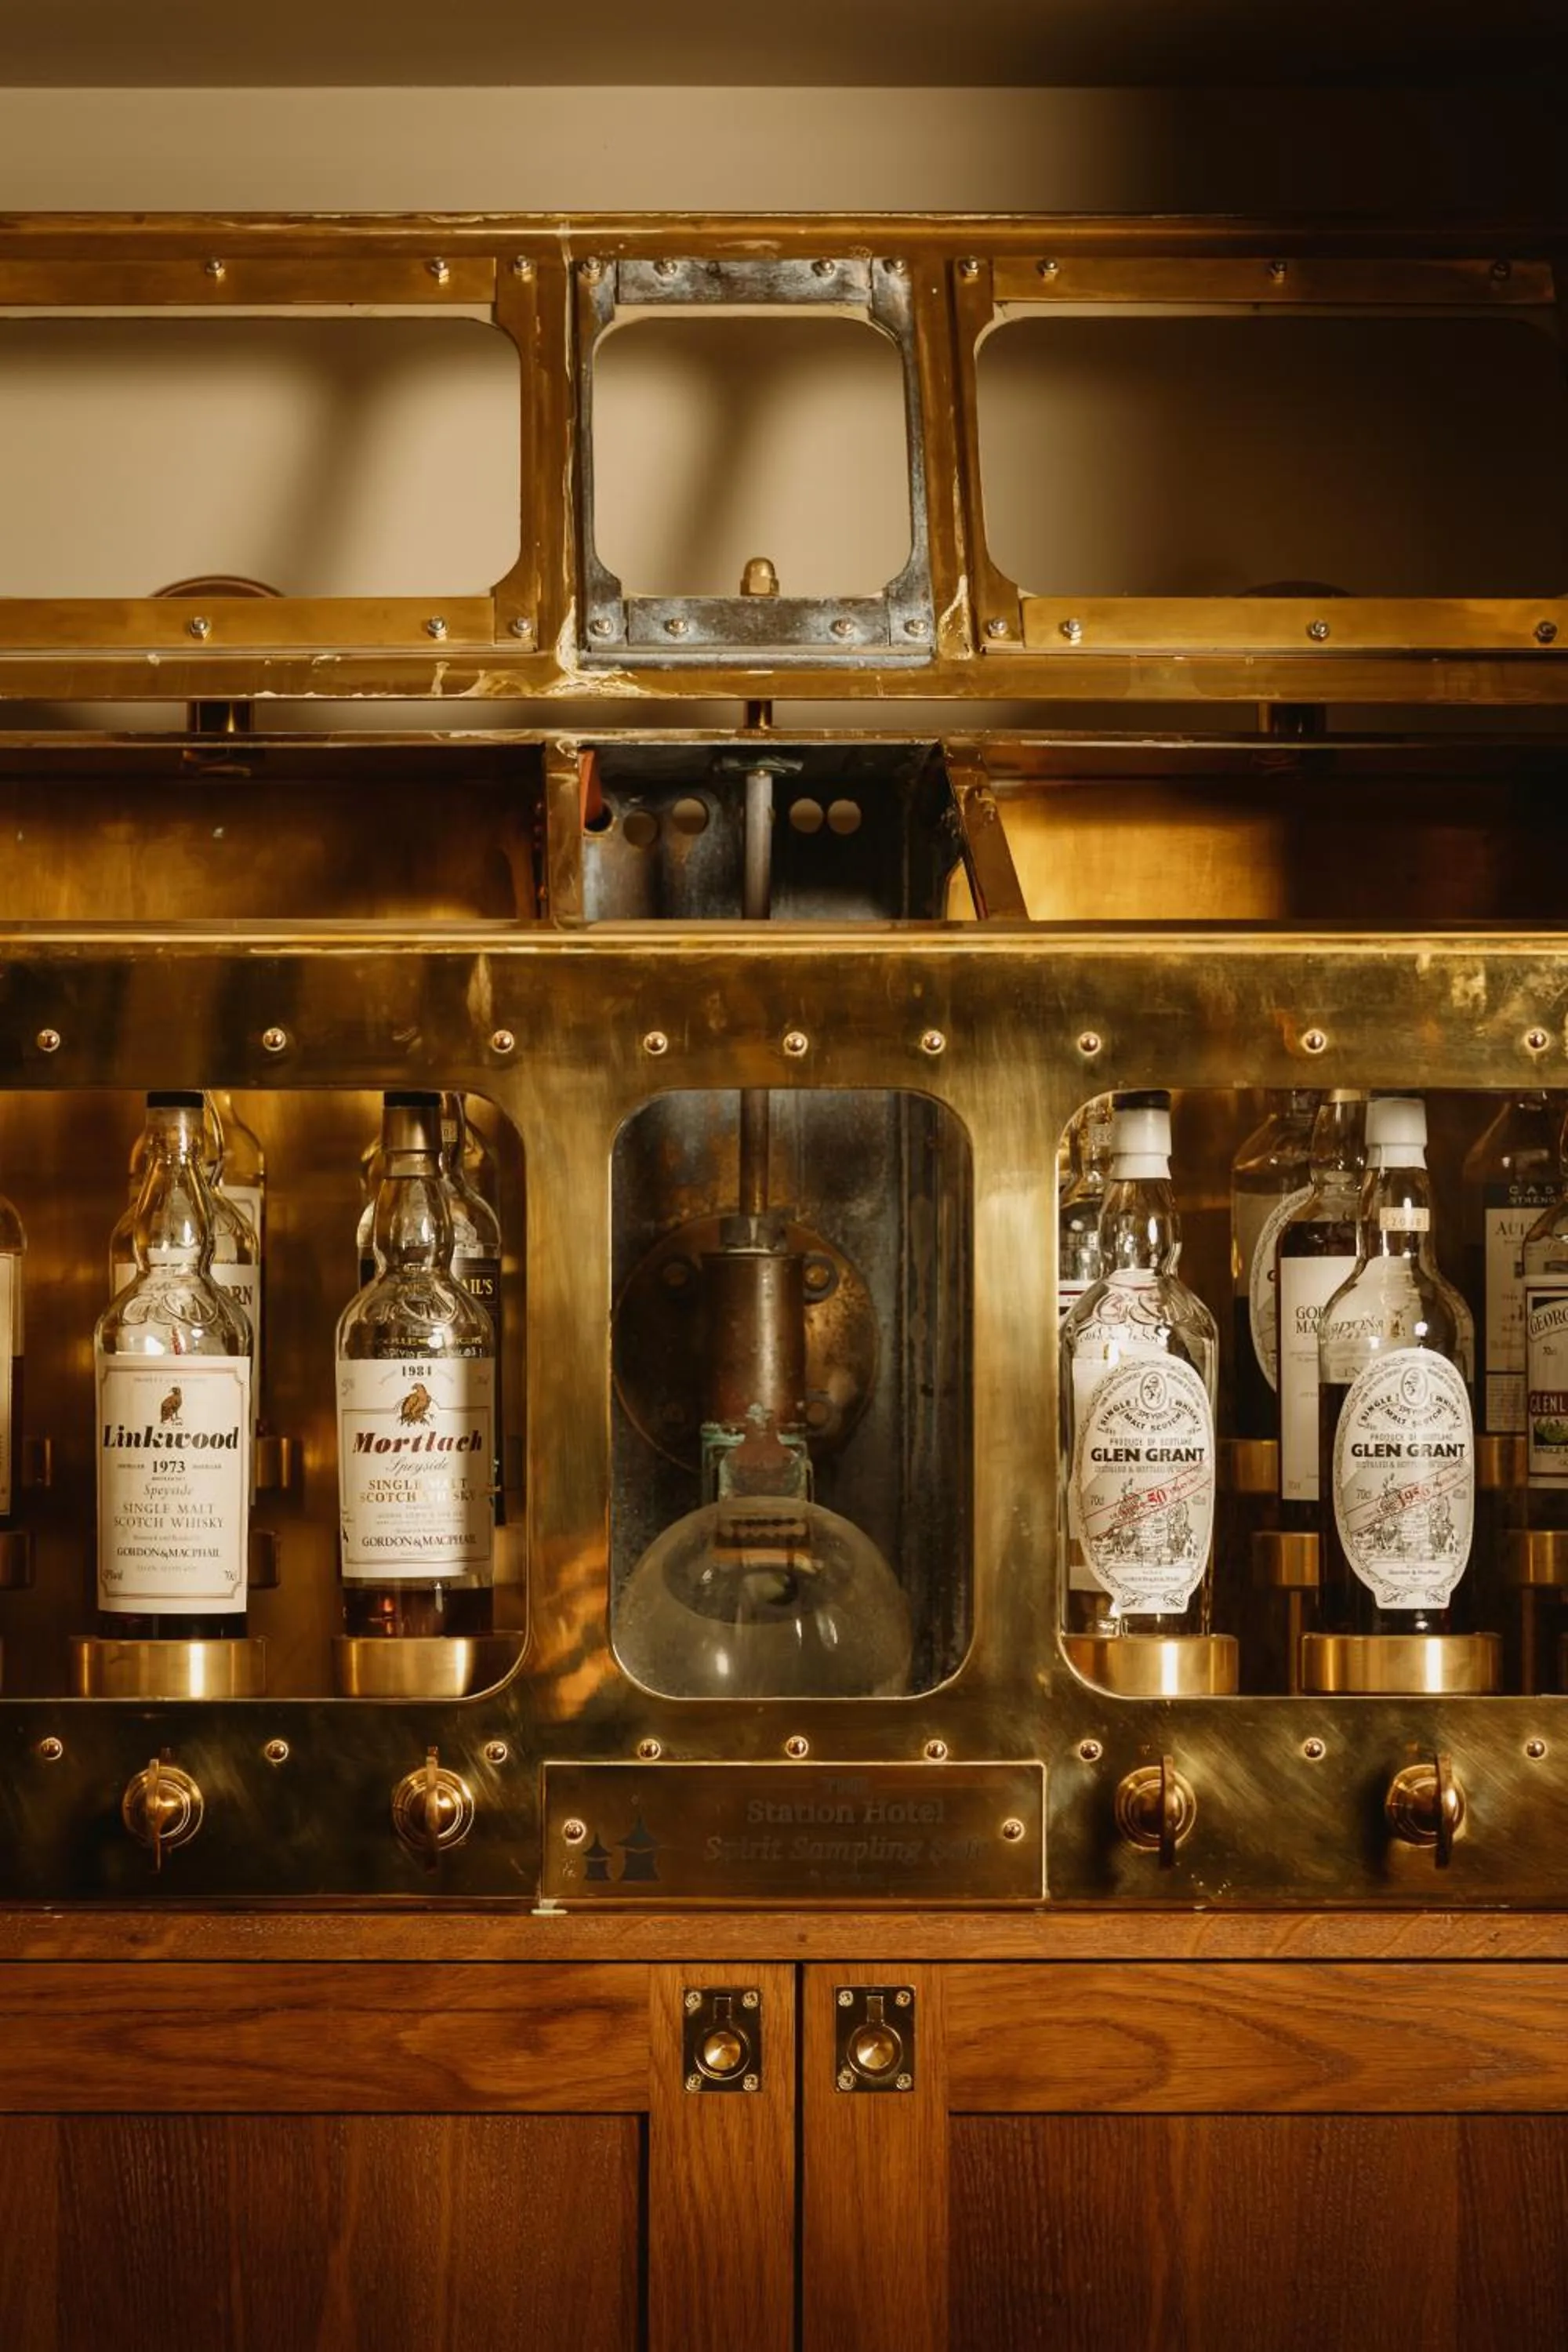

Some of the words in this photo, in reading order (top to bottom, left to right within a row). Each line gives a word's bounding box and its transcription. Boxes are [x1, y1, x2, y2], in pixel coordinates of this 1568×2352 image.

[1412, 1407, 1443, 1428] SOTCH
[103, 1425, 239, 1450] Linkwood
[353, 1429, 483, 1454] Mortlach
[1091, 1447, 1141, 1462] GLEN
[1145, 1447, 1205, 1462] GRANT
[1351, 1443, 1401, 1457] GLEN
[1406, 1443, 1465, 1457] GRANT
[152, 1460, 186, 1473] 1973
[359, 1492, 417, 1504] SCOTCH
[122, 1503, 171, 1515] SINGLE
[177, 1503, 214, 1515] MALT
[114, 1516, 164, 1528] SCOTCH
[171, 1516, 224, 1528] WHISKY
[747, 1798, 855, 1824] Station
[863, 1798, 944, 1824] Hotel
[788, 1836, 924, 1866] Sampling
